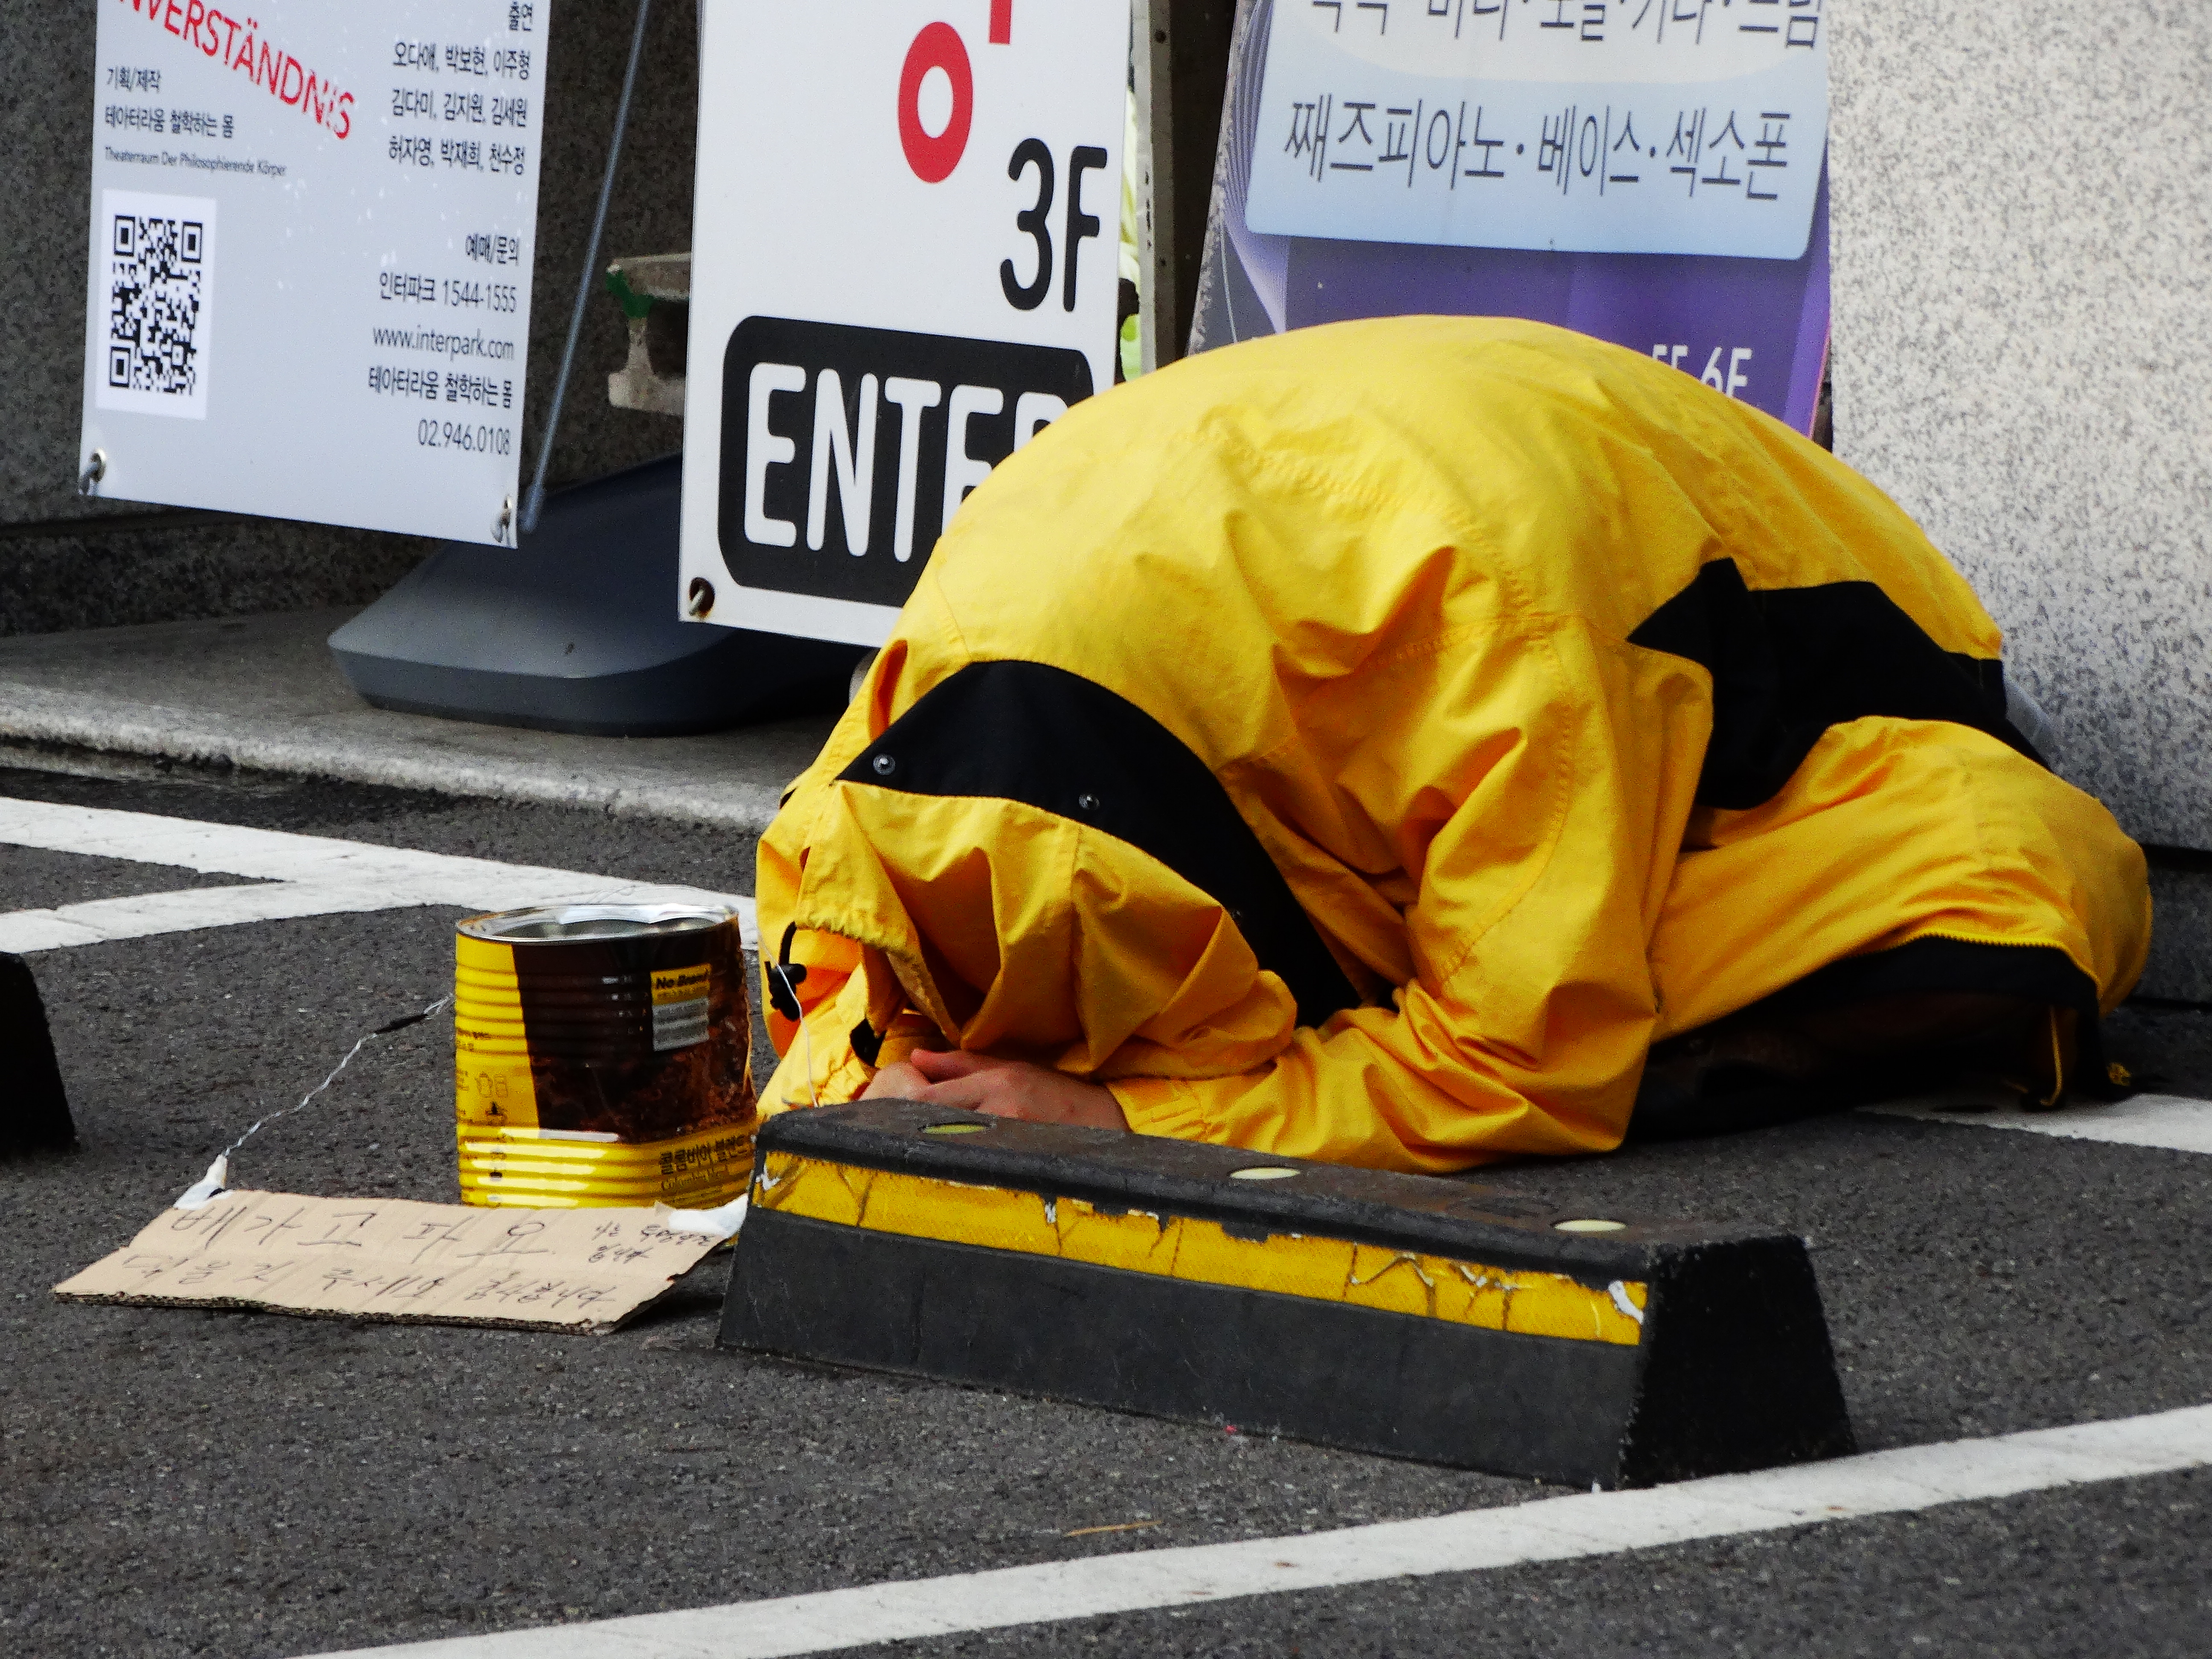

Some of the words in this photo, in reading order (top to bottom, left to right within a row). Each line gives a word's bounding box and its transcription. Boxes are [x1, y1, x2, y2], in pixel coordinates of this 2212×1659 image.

[107, 66, 160, 93] 기획/제작
[494, 47, 530, 80] 이주형
[105, 106, 165, 132] 테아터라움
[170, 110, 216, 137] 철학하는
[223, 114, 234, 138] 몸
[392, 88, 437, 120] 김다미,
[444, 92, 486, 123] 김지원,
[1000, 138, 1108, 313] 3F
[466, 233, 520, 266] 예매/문의
[380, 272, 437, 303] 인터파크
[443, 278, 518, 314] 1544-1555
[373, 324, 514, 361] www.interpark.com
[368, 366, 439, 399] 테아터라움
[444, 372, 498, 407] 철학하는
[503, 380, 512, 408] 몸
[418, 419, 511, 455] 02.946.0108
[656, 977, 674, 989] No
